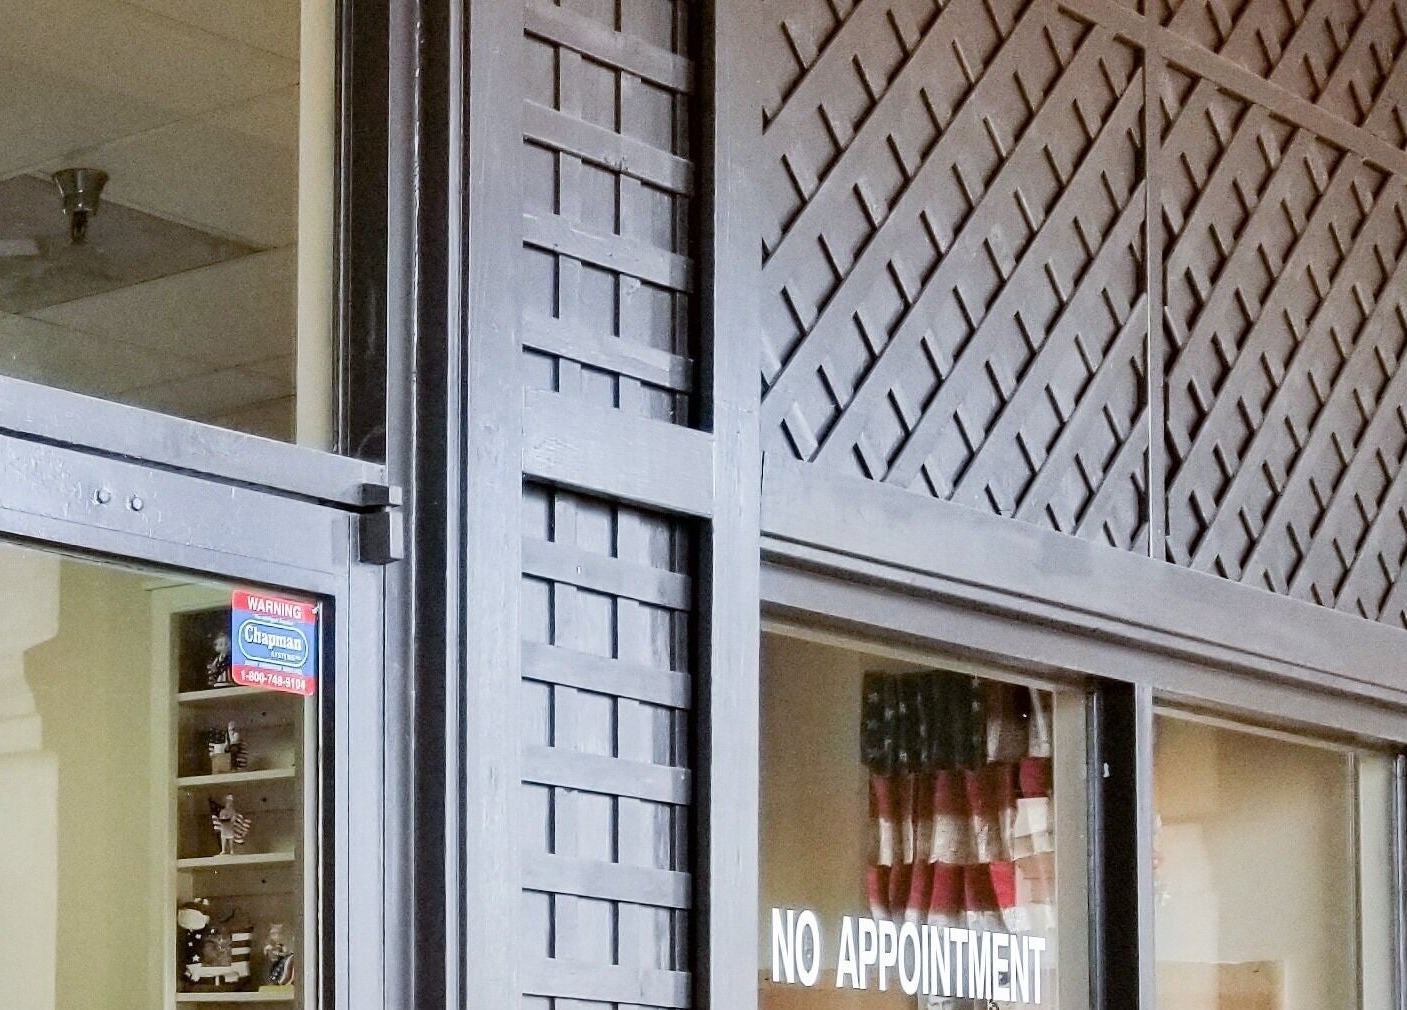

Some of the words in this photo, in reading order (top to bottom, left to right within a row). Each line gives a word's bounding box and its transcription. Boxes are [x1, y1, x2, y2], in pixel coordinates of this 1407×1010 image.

[247, 595, 302, 619] WARNING
[244, 624, 302, 651] Chapman
[771, 907, 820, 987] NO
[835, 915, 1046, 1005] APPOINTMENT
